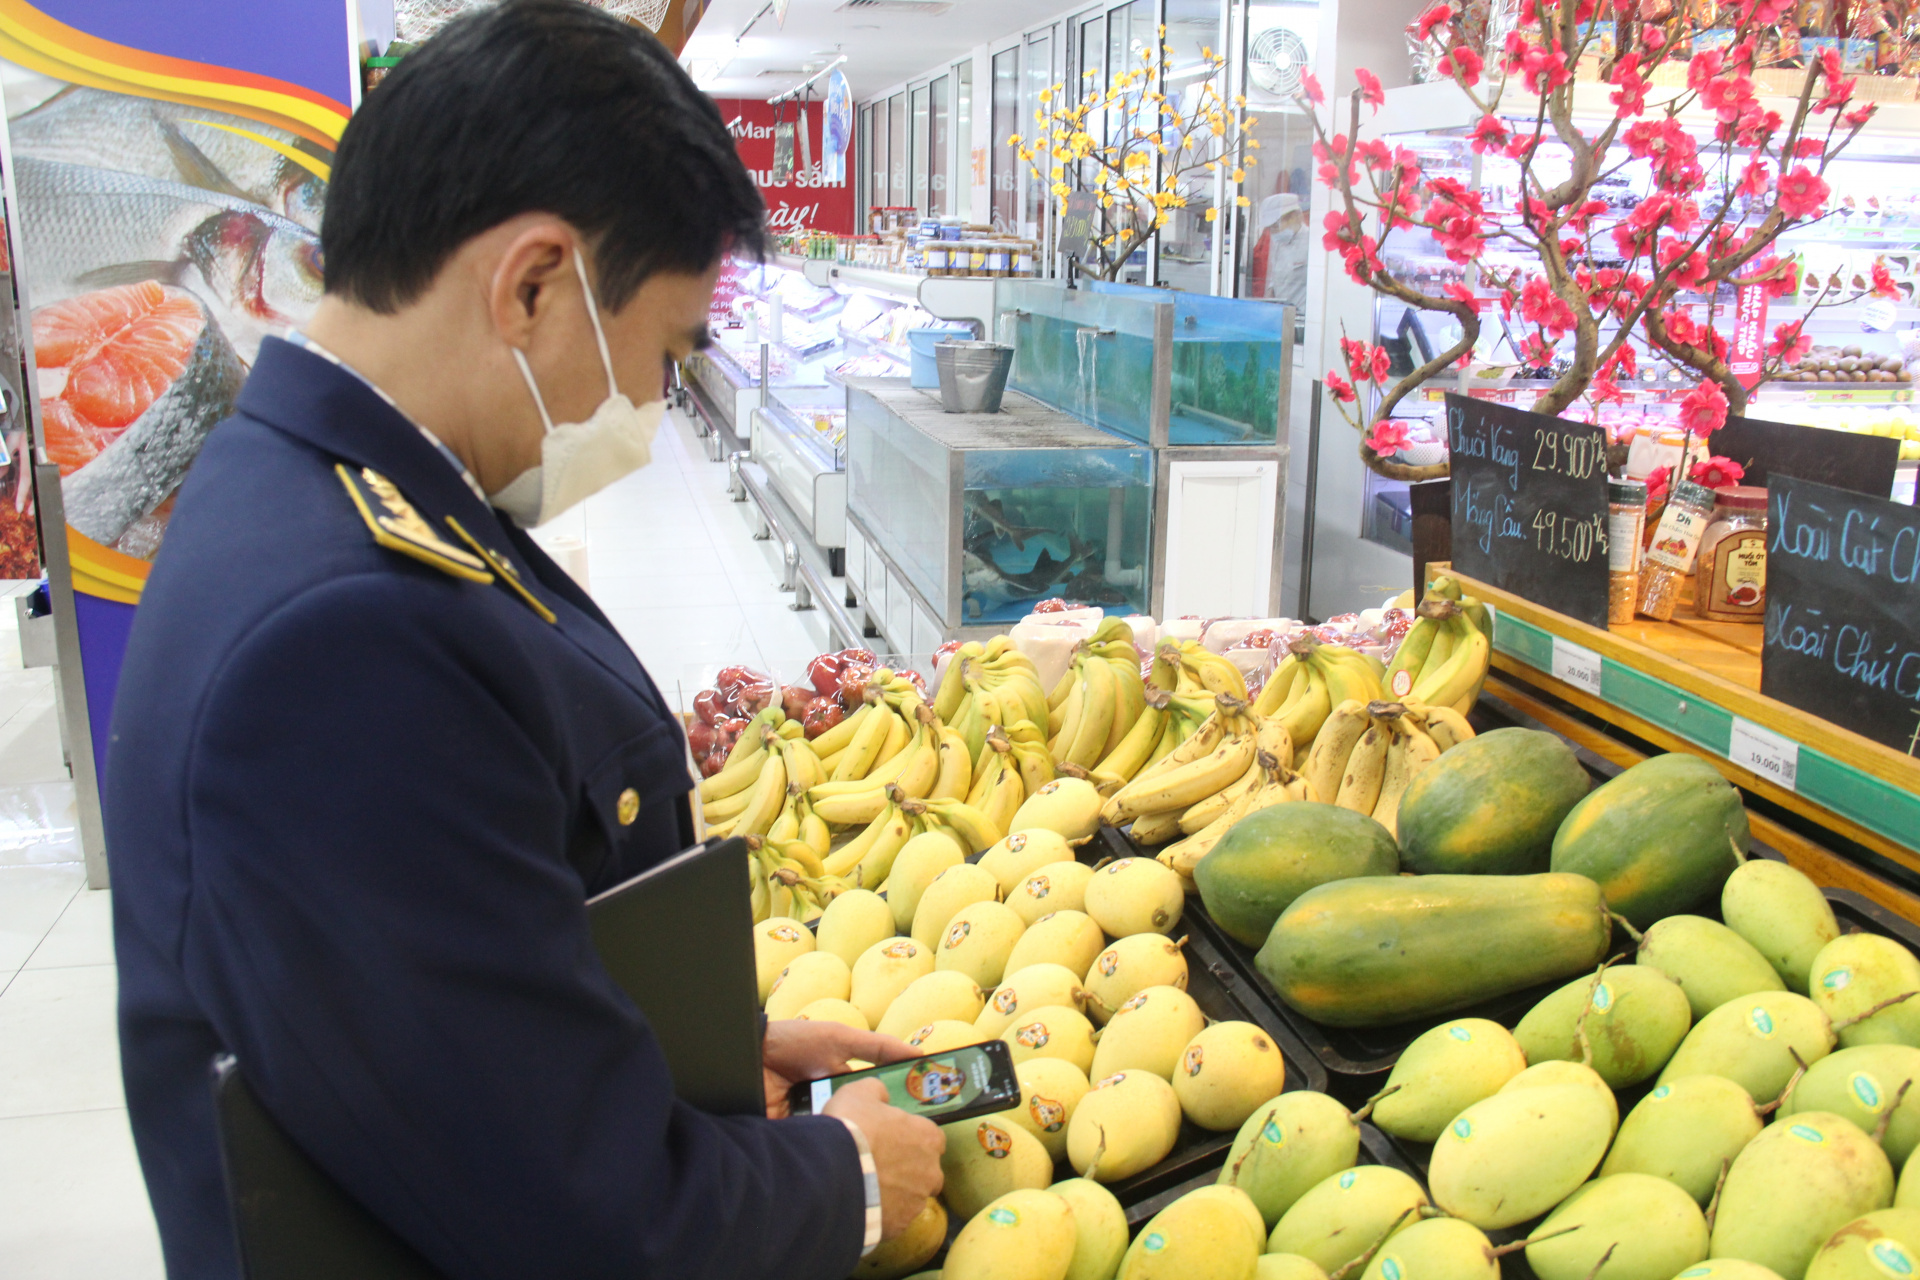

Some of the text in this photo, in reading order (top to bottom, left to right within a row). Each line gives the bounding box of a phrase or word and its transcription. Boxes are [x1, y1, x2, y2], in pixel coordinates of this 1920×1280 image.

[731, 121, 774, 139] Mar
[766, 200, 819, 233] ày!
[1771, 490, 1833, 561] Xoài
[1840, 509, 1884, 575] Cát
[1767, 605, 1830, 659] Xoài
[1752, 752, 1779, 773] 19.000
